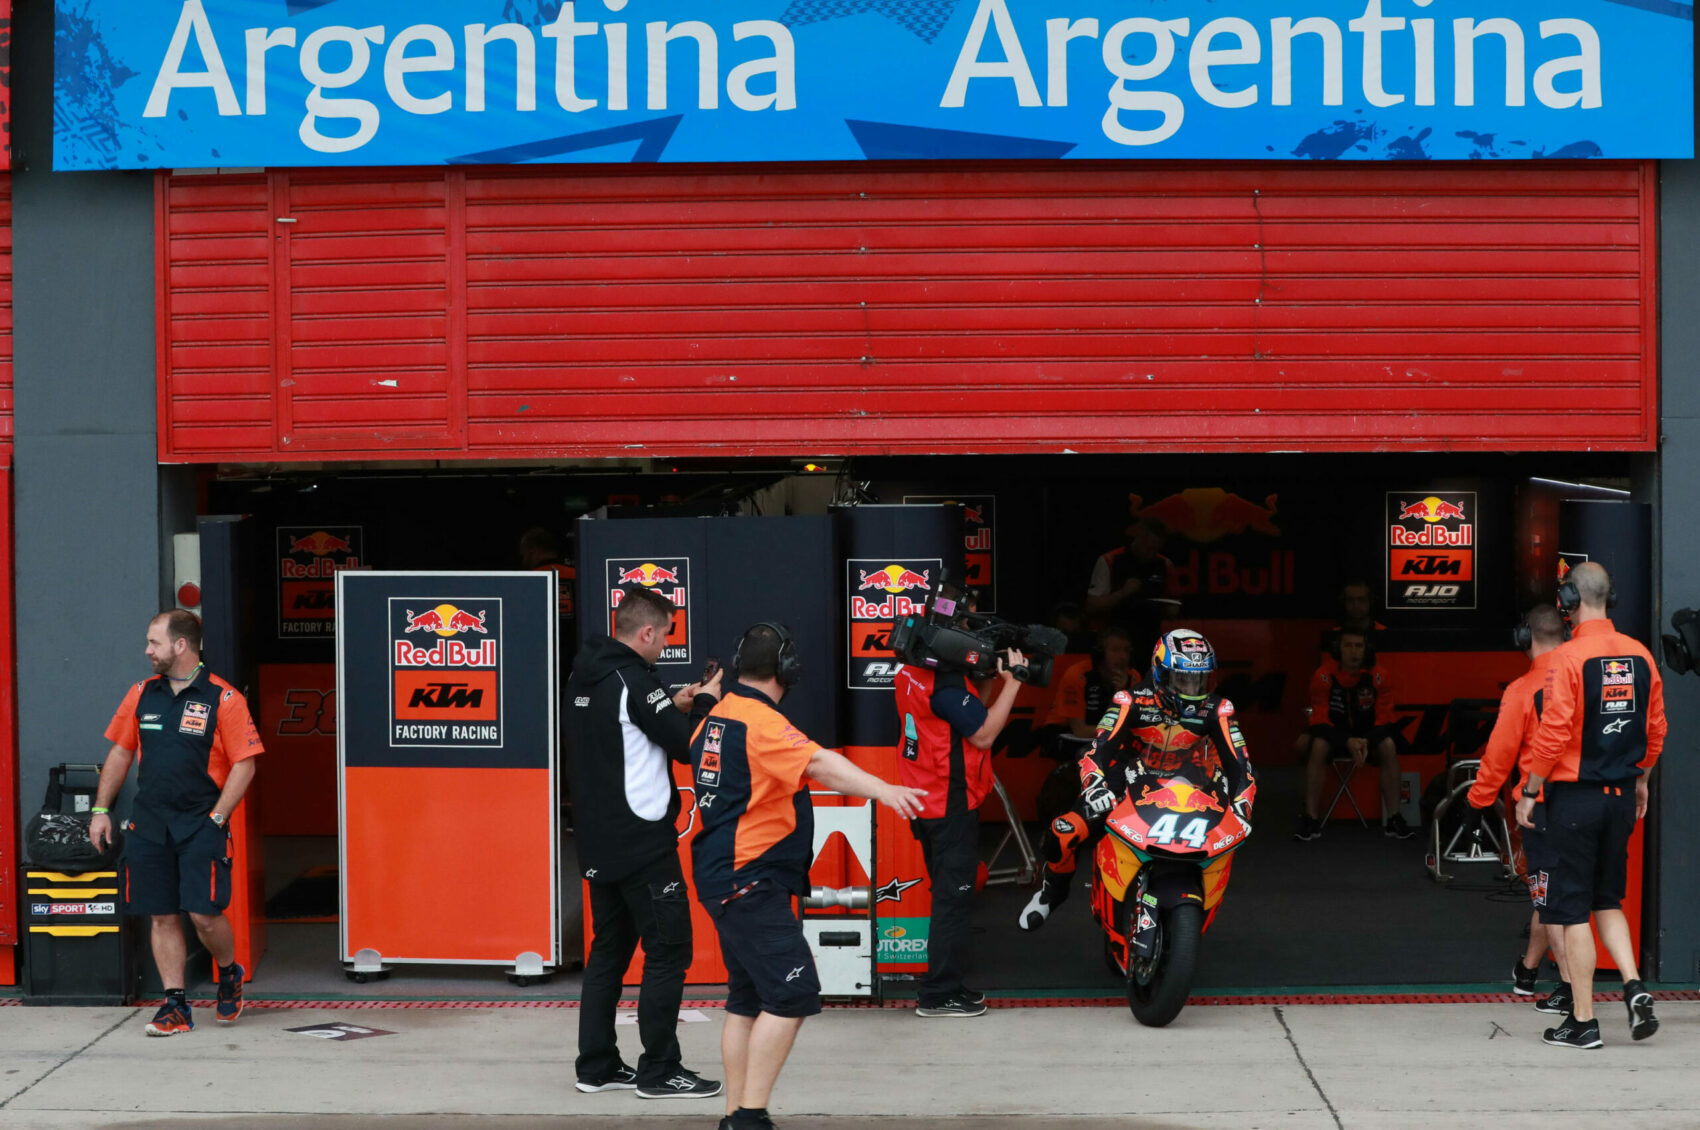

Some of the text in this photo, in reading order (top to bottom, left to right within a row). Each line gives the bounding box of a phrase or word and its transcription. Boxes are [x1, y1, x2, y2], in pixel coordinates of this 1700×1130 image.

[143, 0, 797, 154] Argentina
[939, 0, 1603, 146] Argentina
[965, 527, 991, 550] ull
[1391, 524, 1472, 546] Red Bull
[281, 557, 320, 578] Red
[1208, 549, 1295, 596] Bull
[1401, 555, 1462, 576] KTM
[1404, 585, 1460, 597] AJO
[851, 595, 929, 619] Red Bu
[282, 622, 322, 633] FACTORY
[394, 639, 497, 667] Red Bull
[657, 648, 687, 659] ACING
[863, 662, 904, 677] AJ
[408, 683, 484, 708] KTM
[1605, 687, 1629, 699] KTM
[395, 725, 498, 740] FACTORY RACING
[1147, 814, 1210, 848] 44
[33, 904, 50, 914] sky
[51, 904, 85, 913] SPORT
[876, 938, 928, 952] OTOREX
